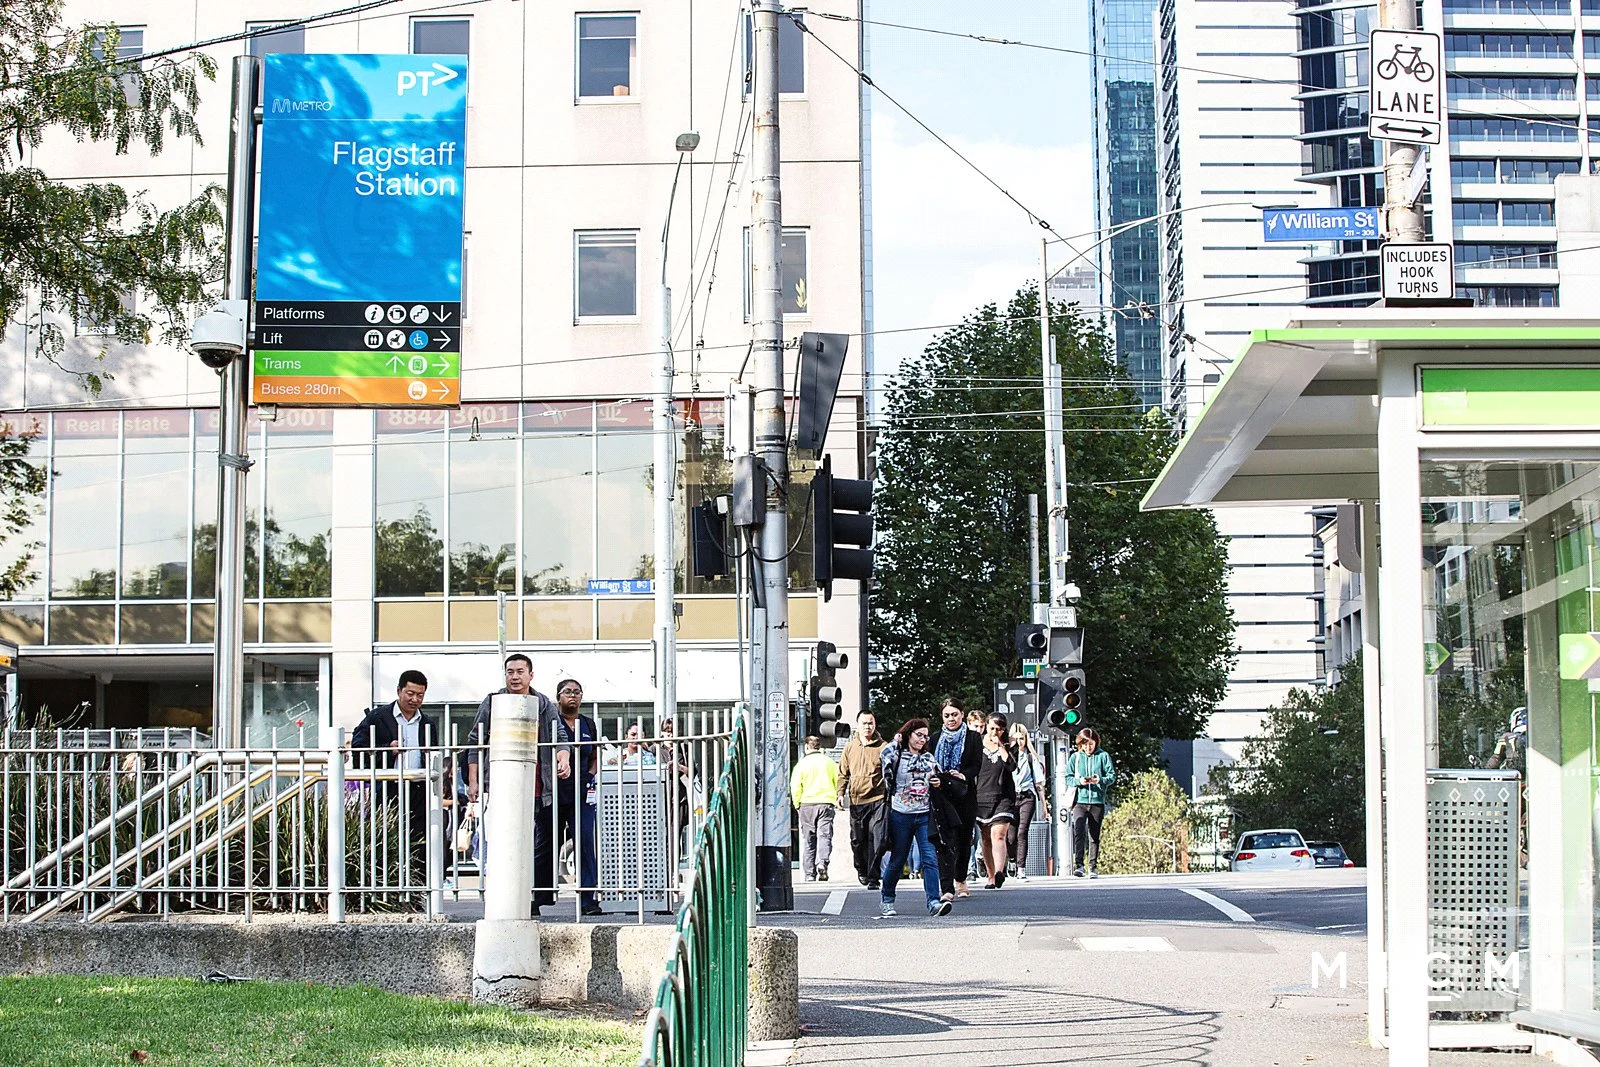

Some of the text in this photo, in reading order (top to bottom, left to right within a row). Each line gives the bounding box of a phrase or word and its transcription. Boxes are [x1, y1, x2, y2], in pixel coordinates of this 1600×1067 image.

[292, 100, 333, 112] METRO
[1377, 91, 1434, 114] LANE
[333, 141, 457, 172] Flagstaff
[355, 171, 456, 197] Station
[1281, 211, 1375, 229] William St
[1344, 229, 1355, 237] 311
[1386, 251, 1447, 264] INCLUDES
[1400, 266, 1434, 279] HOOK
[1397, 282, 1439, 294] TURNS
[263, 307, 325, 320] Platforms
[262, 332, 283, 345] Lift
[262, 357, 302, 369] Trams
[261, 383, 341, 396] Buses 280m
[66, 418, 106, 433] Real
[112, 416, 170, 432] Estate
[590, 580, 620, 590] William
